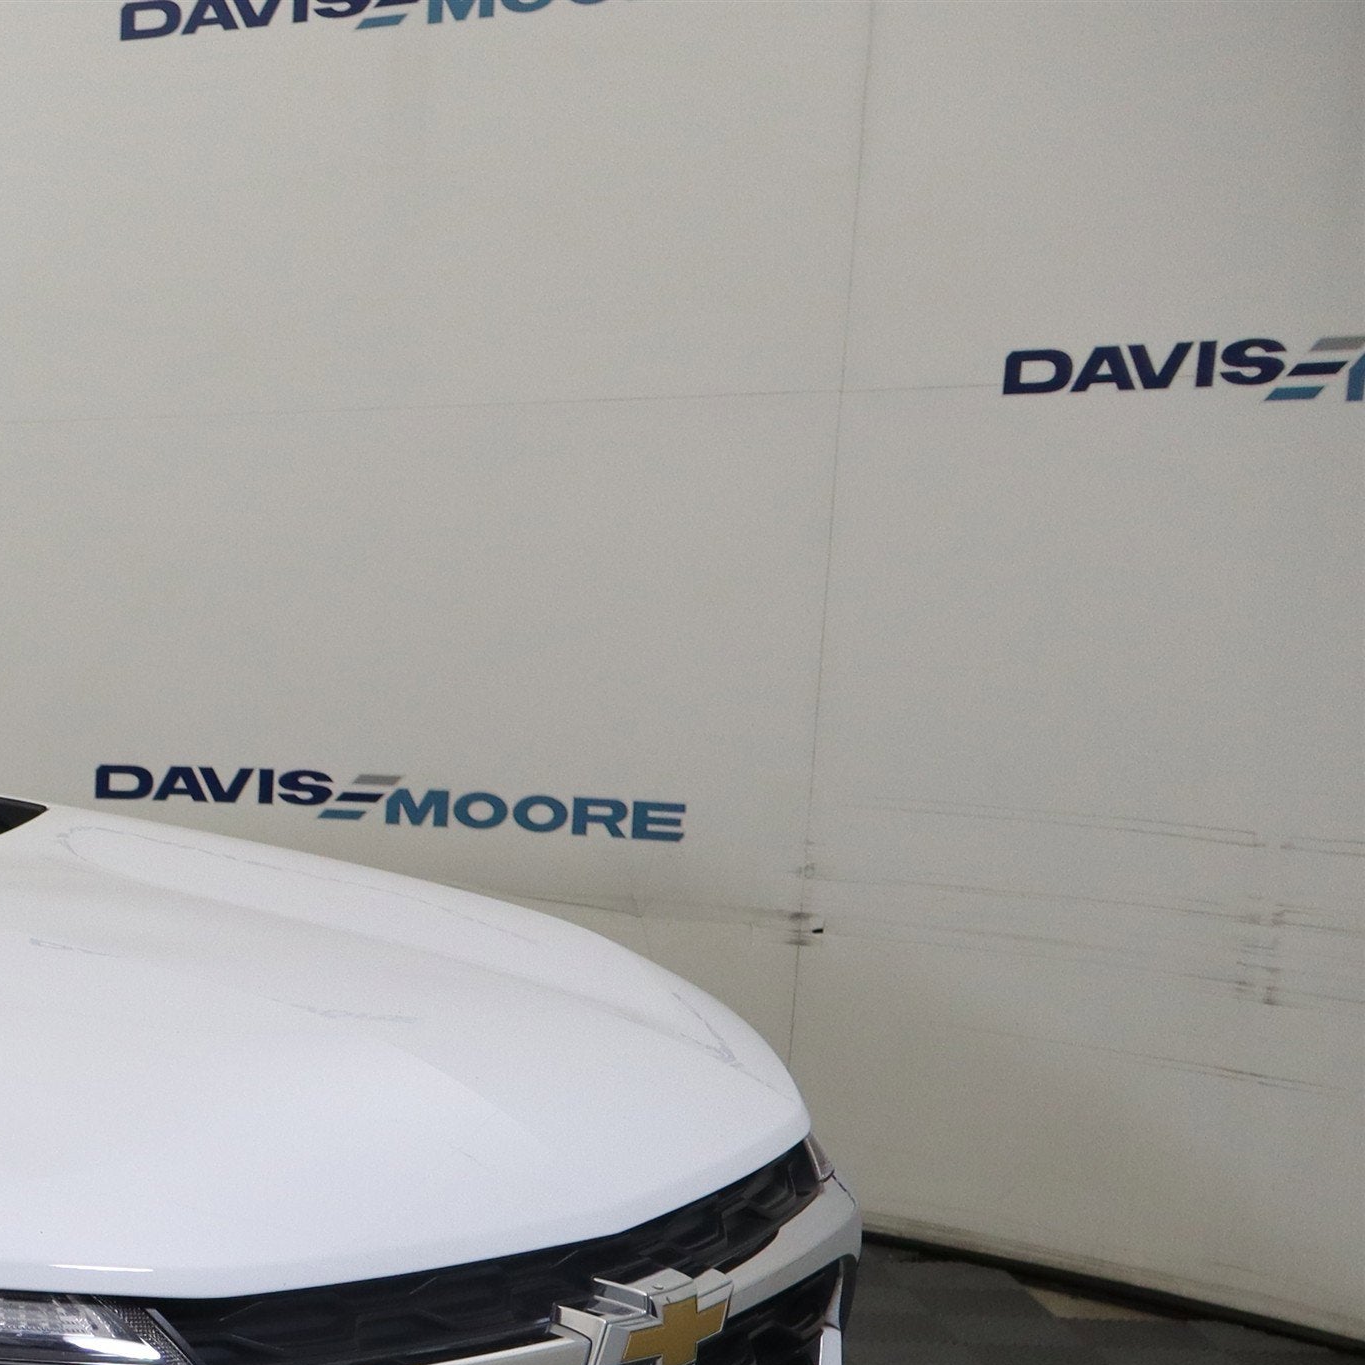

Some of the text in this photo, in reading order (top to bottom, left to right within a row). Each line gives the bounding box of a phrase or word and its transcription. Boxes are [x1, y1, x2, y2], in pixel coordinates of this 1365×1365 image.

[1002, 338, 1287, 396] DAVIS
[94, 764, 687, 843] DAVIS MOORE
